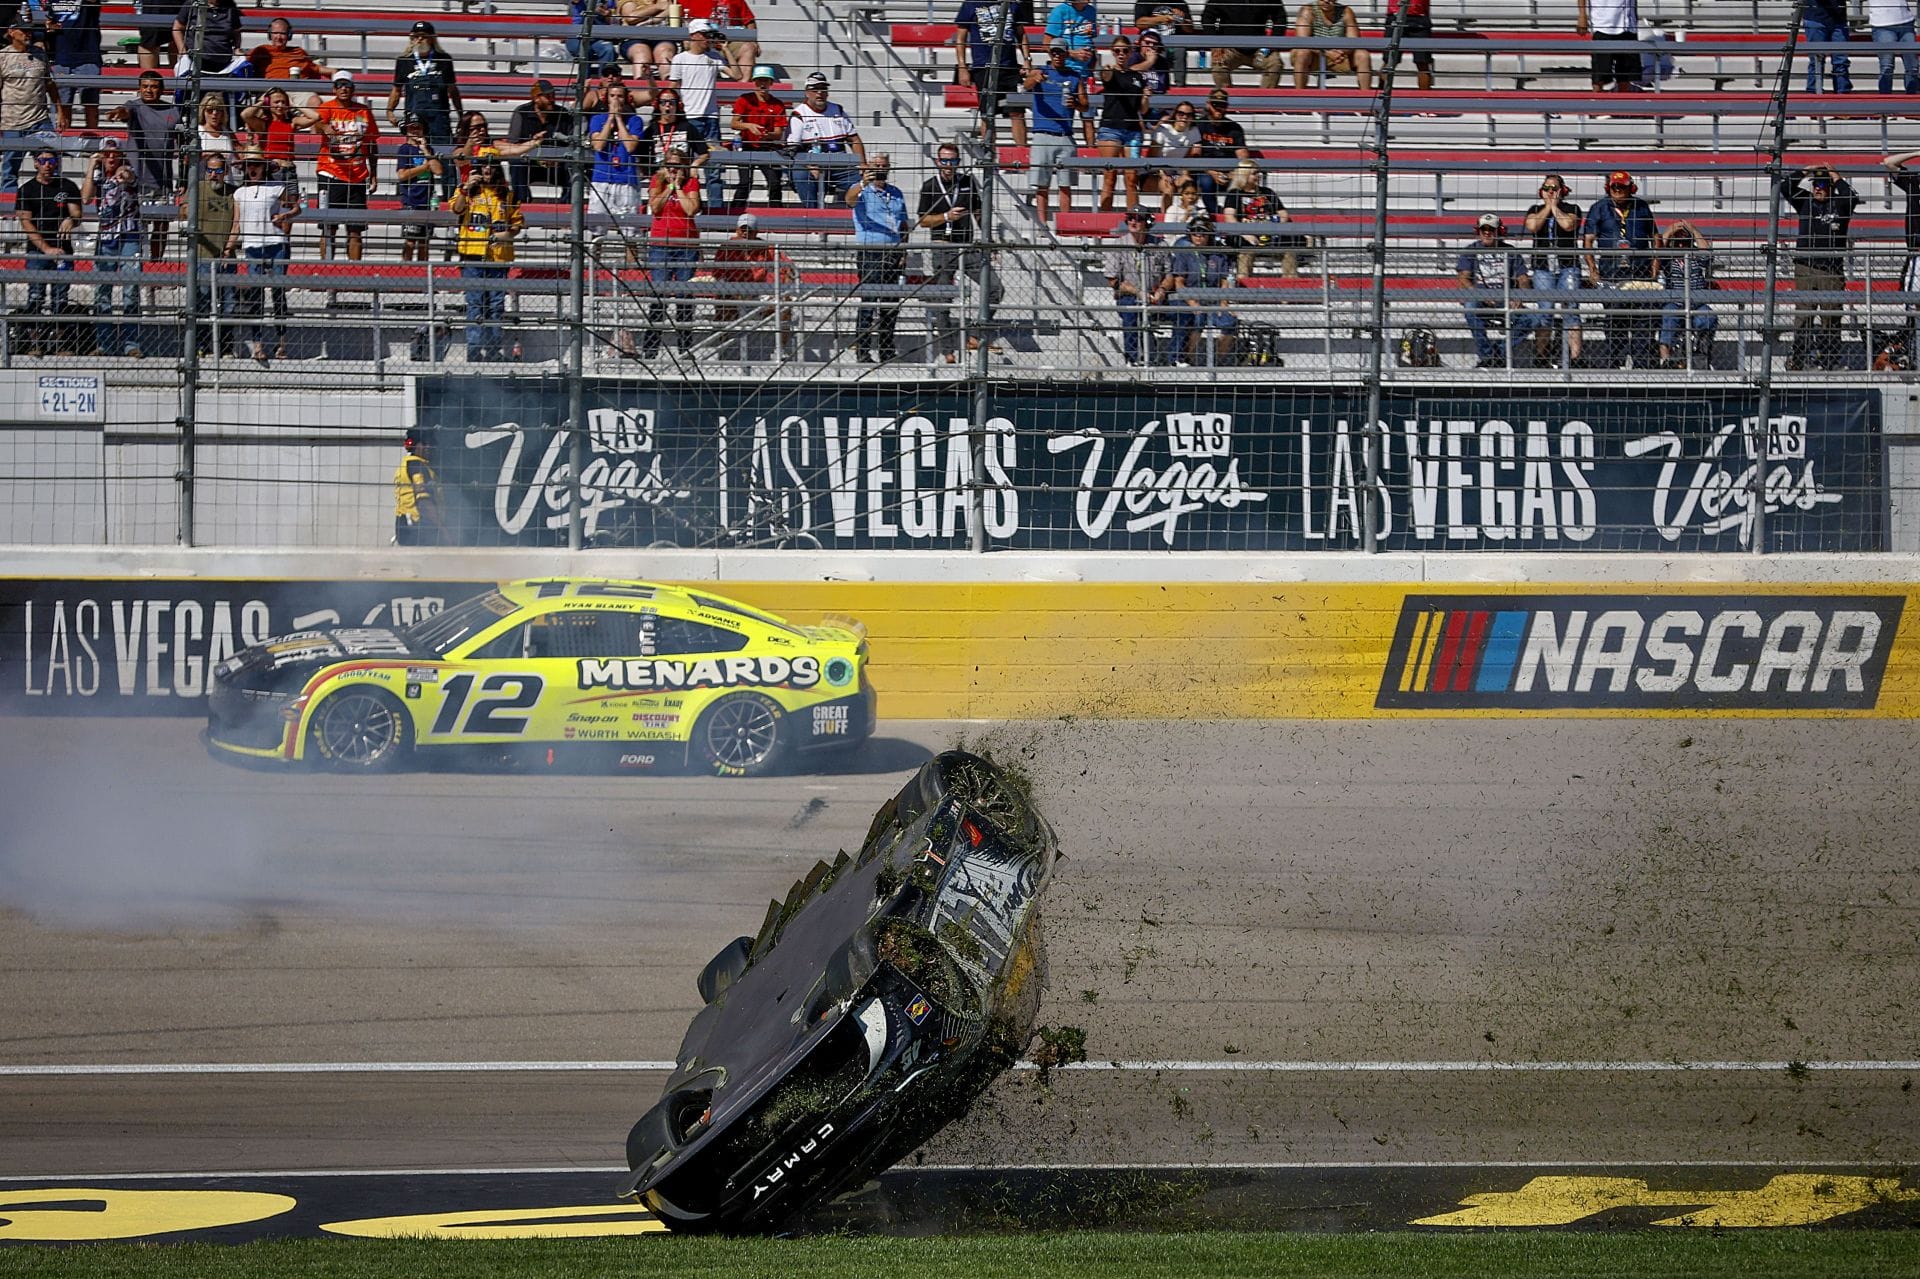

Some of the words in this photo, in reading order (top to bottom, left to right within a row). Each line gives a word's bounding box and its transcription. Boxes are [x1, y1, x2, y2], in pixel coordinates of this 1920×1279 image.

[41, 377, 96, 387] SECTIONS
[53, 392, 95, 413] 2L-2N
[595, 413, 648, 448] LAS
[1173, 417, 1224, 452] LAS
[465, 419, 691, 538] Vegas
[719, 415, 811, 537] LAS
[823, 416, 1019, 539] VEGAS
[1047, 420, 1268, 546] Vegas
[1301, 419, 1392, 541] LAS
[1404, 419, 1597, 542] VEGAS
[1625, 423, 1844, 549] Vegas
[697, 612, 741, 627] ADVANCE
[25, 600, 100, 697] LAS
[1514, 610, 1883, 693] NASCAR
[337, 667, 392, 682] GOODYEAR
[578, 655, 820, 689] MENARDS
[431, 672, 545, 737] 12
[632, 713, 680, 722] DISCOUNT
[812, 705, 849, 719] GREAT
[627, 730, 682, 741] WABASH
[645, 721, 667, 729] TIRE
[812, 719, 848, 736] STUFF
[619, 753, 655, 765] FORD
[753, 1123, 834, 1201] CAMRY
